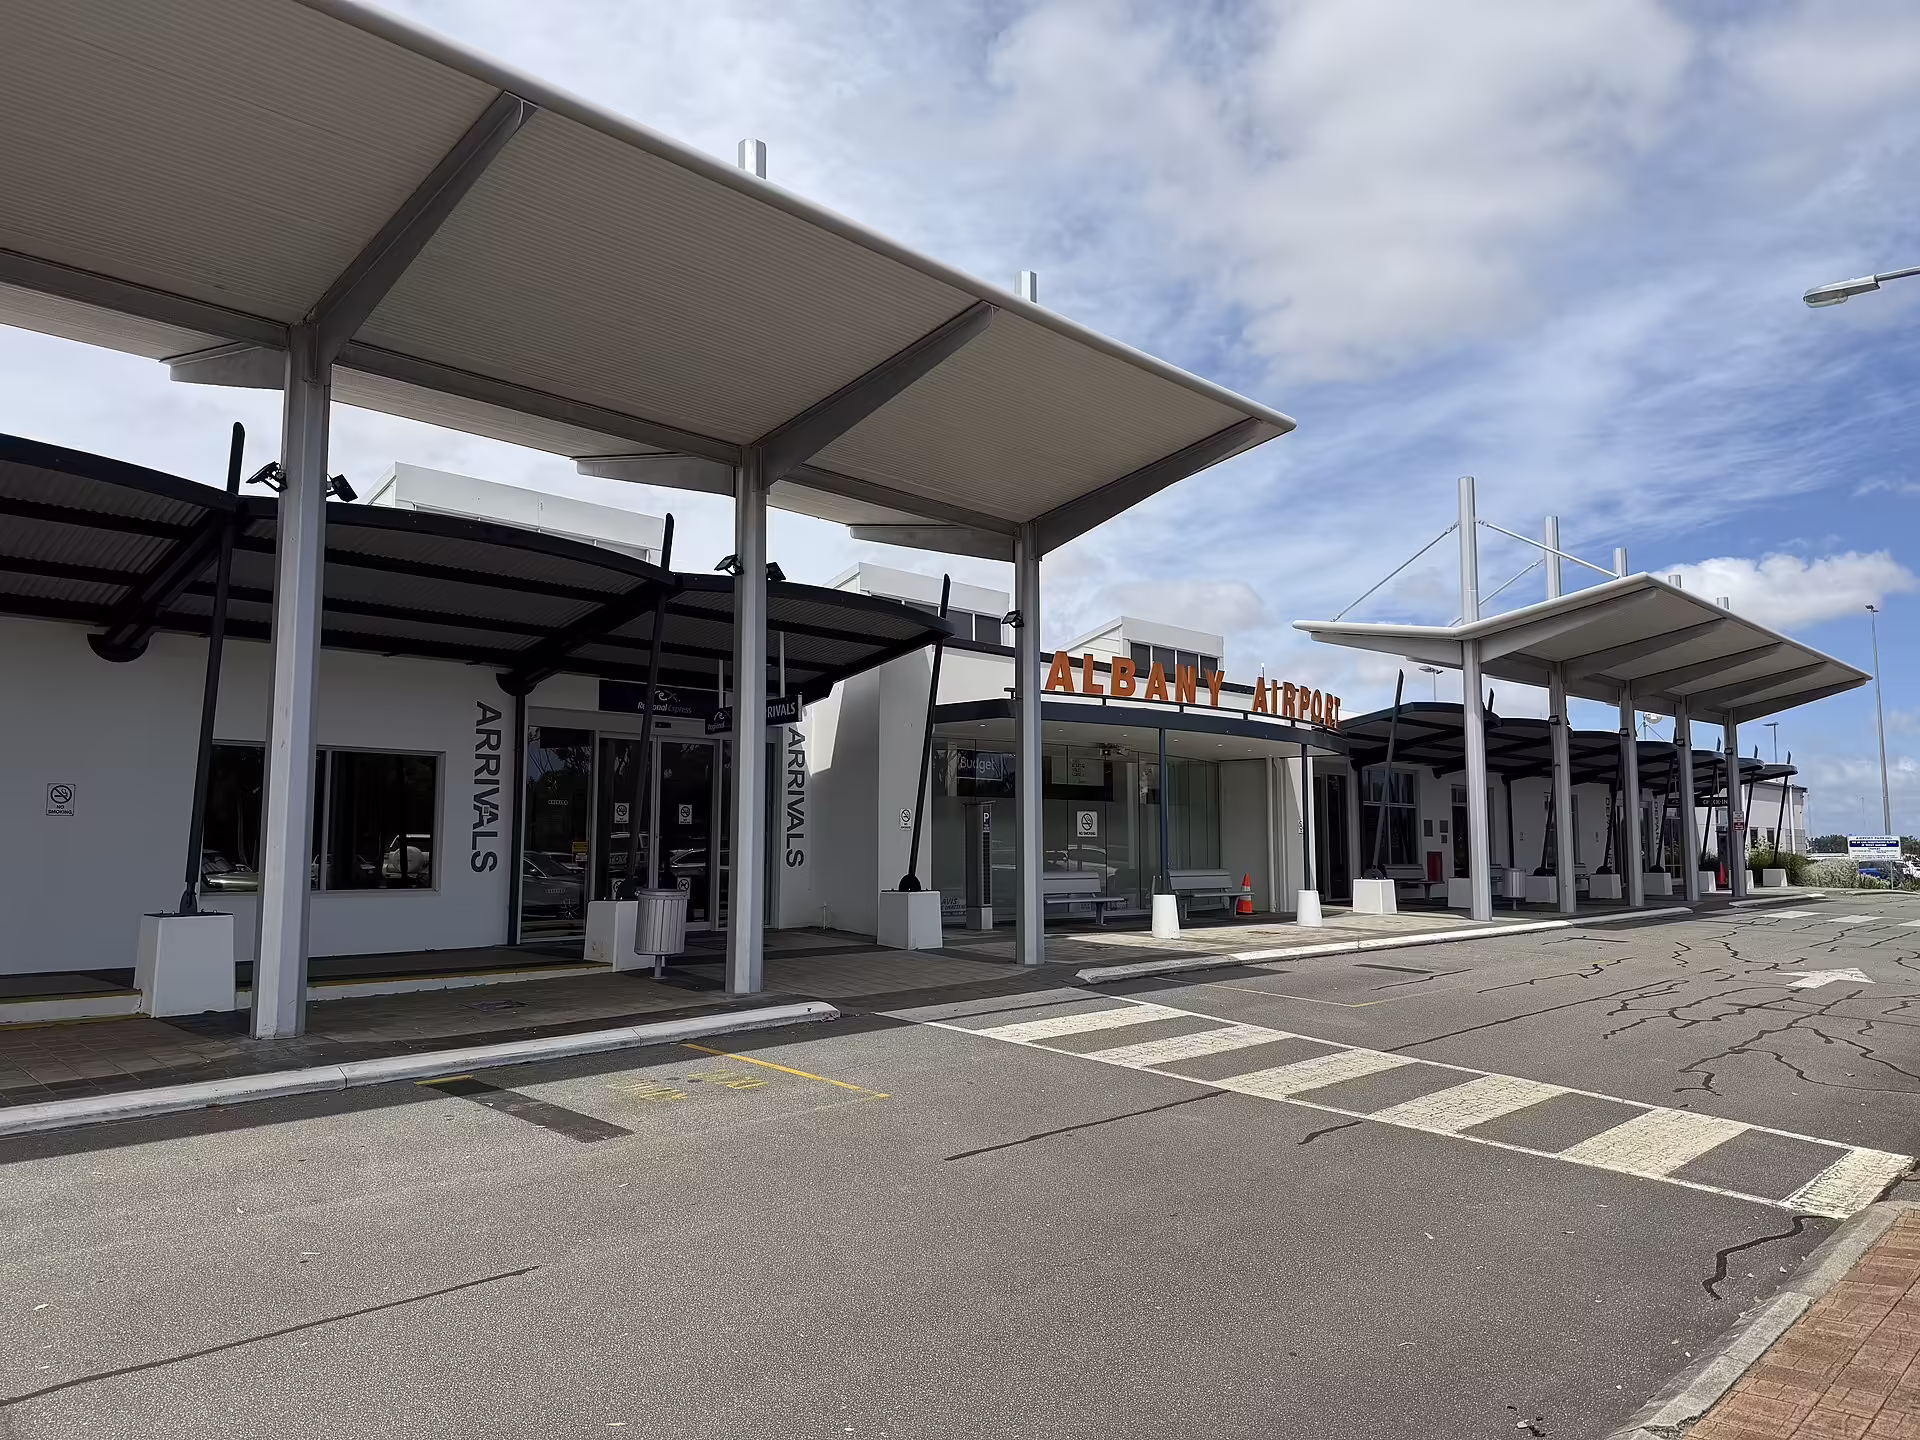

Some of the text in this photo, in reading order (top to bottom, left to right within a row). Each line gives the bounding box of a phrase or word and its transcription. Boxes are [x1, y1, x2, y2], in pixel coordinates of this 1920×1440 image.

[668, 704, 692, 714] Express
[766, 702, 796, 718] RIVALS
[1045, 651, 1341, 728] ALBANY AIRPORT
[471, 700, 503, 873] ARRIVALS
[960, 757, 996, 774] Budget
[786, 726, 806, 868] ARRIVALS
